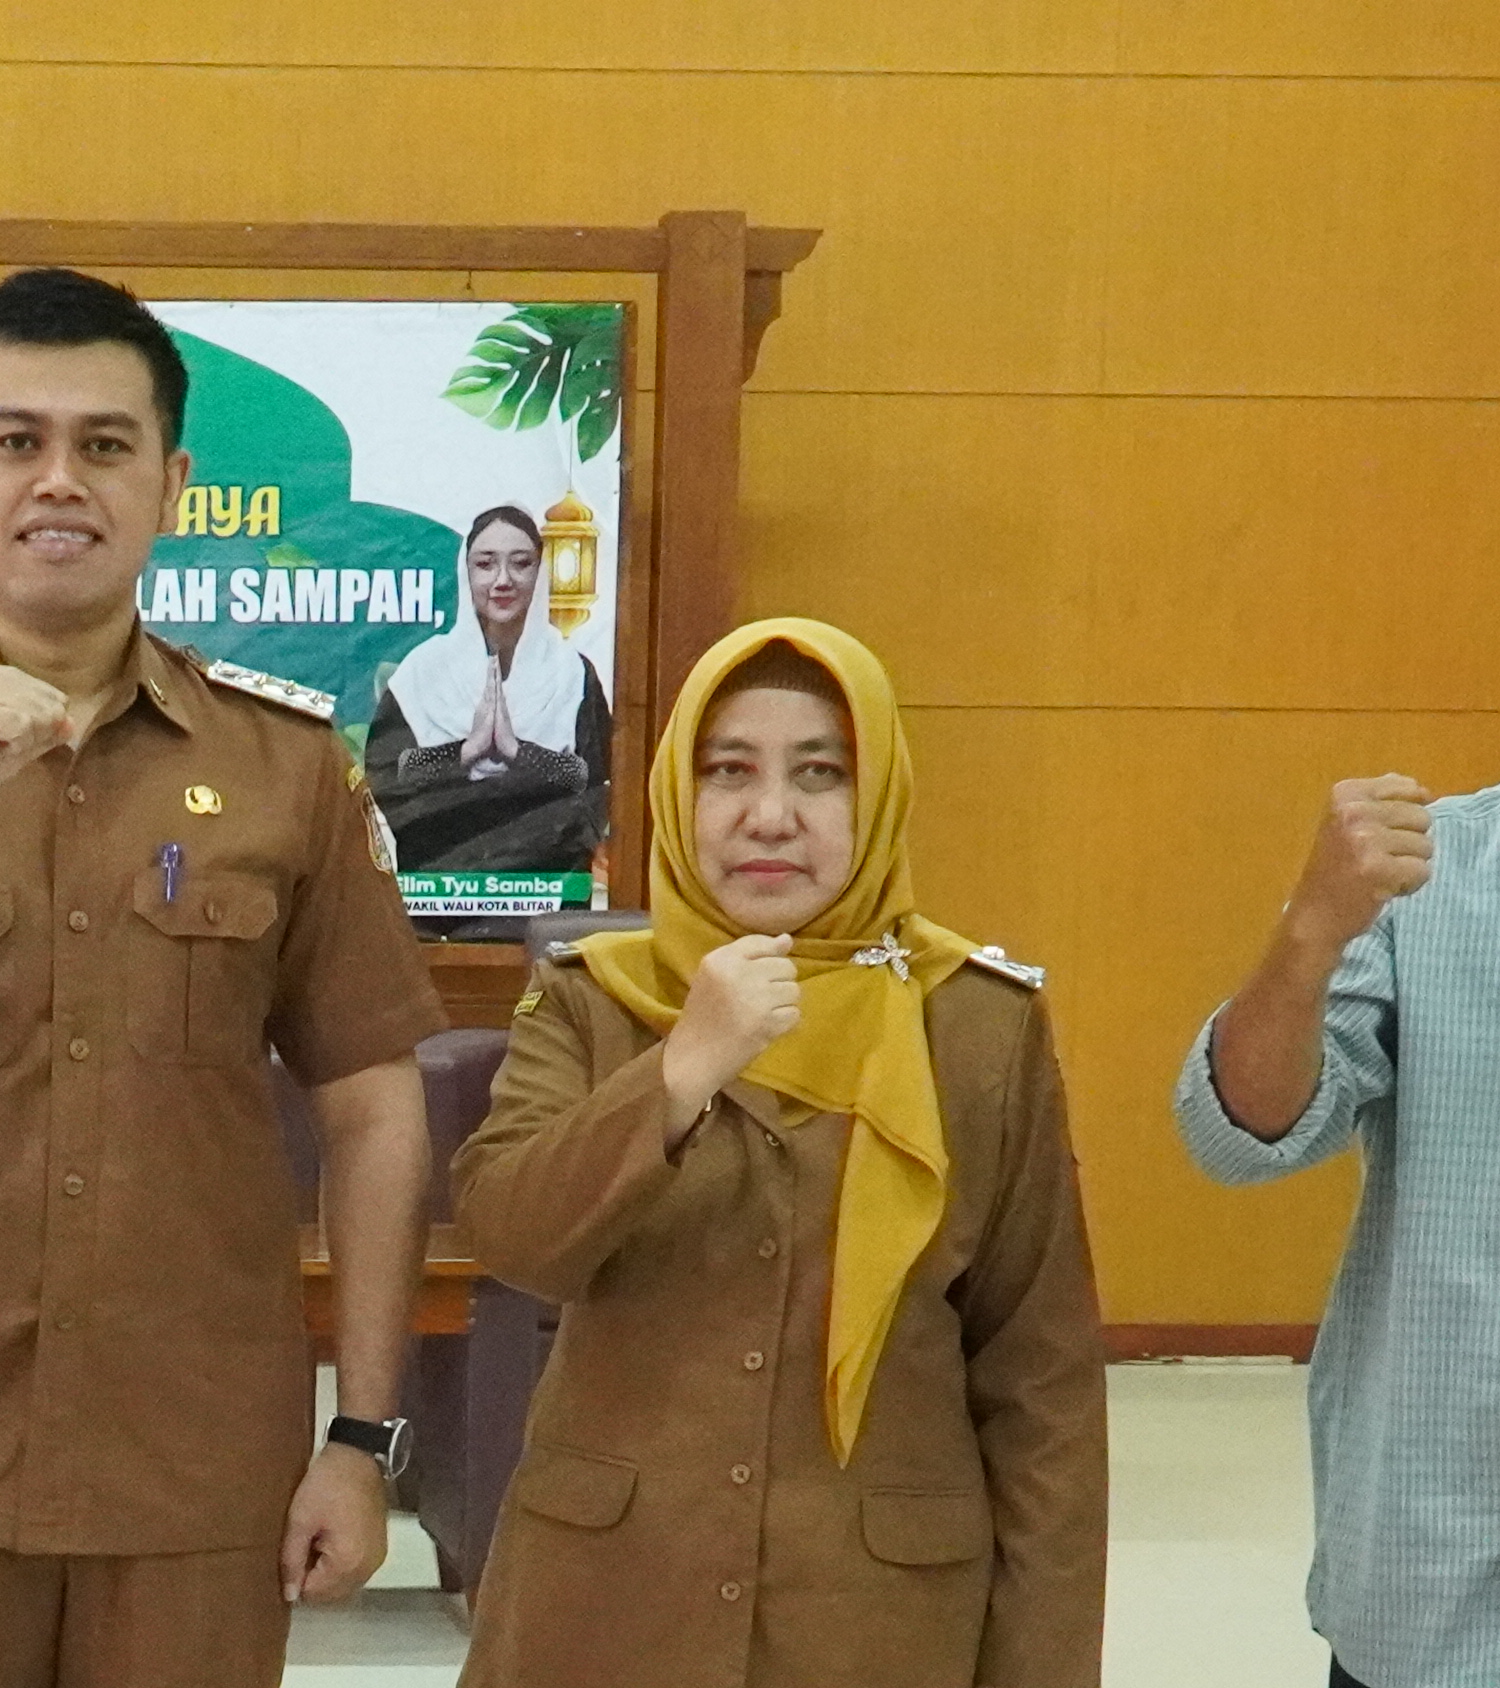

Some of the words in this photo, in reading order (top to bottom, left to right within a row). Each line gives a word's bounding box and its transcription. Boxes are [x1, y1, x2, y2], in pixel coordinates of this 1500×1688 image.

[175, 485, 280, 537] AYA
[136, 568, 217, 622] LAH
[230, 567, 445, 629] SAMPAH,
[441, 876, 479, 897] Tyu
[485, 876, 563, 894] Samba
[443, 901, 474, 912] WALI
[477, 901, 510, 911] KOTA
[513, 901, 554, 912] BLITAR
